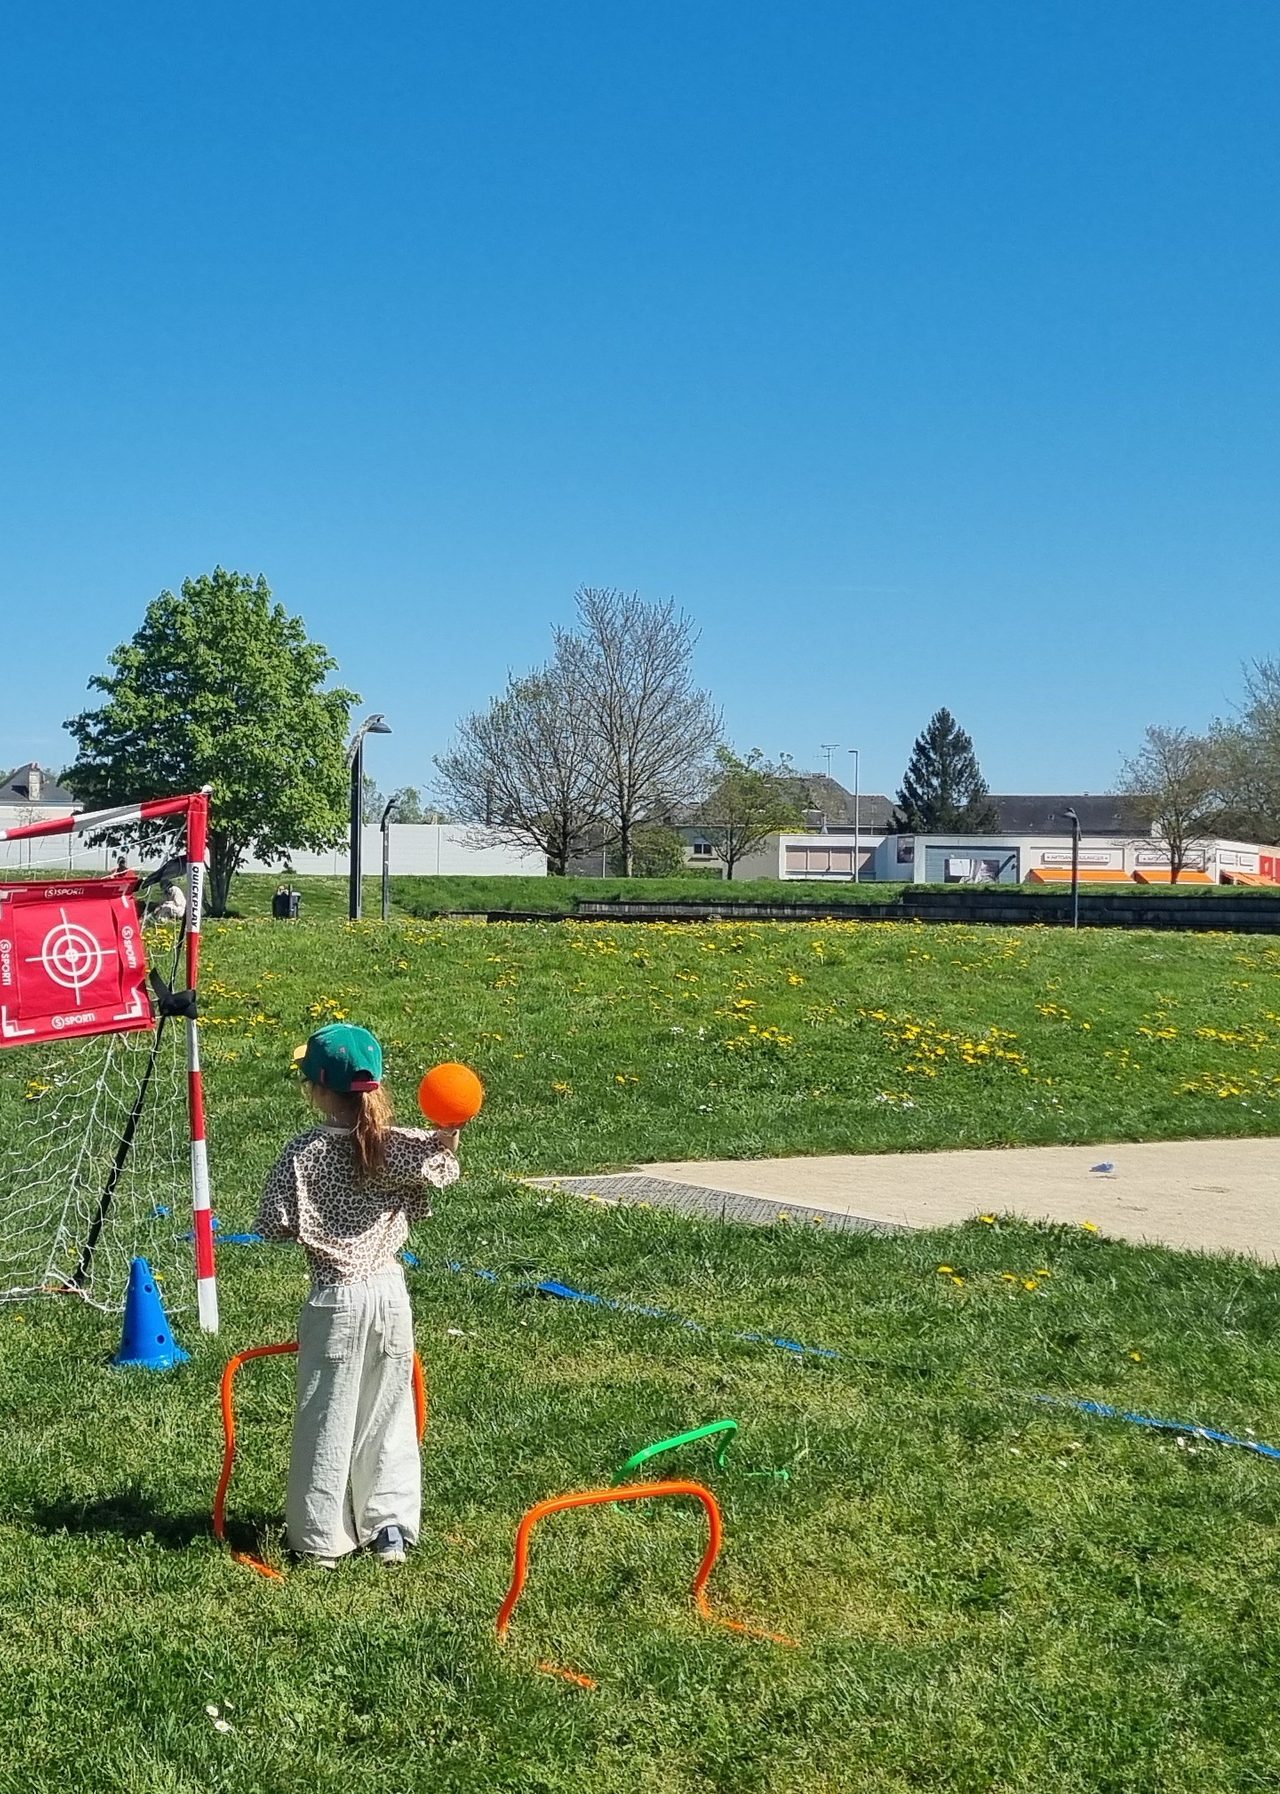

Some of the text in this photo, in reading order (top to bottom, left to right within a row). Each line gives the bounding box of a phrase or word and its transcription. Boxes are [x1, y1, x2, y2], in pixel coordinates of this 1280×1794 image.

[57, 888, 84, 896] SPORTI
[191, 865, 200, 928] QUICKPLAY
[123, 939, 137, 969] SPORTI
[0, 953, 12, 986] SPORTI
[64, 1013, 95, 1024] SPORTI
